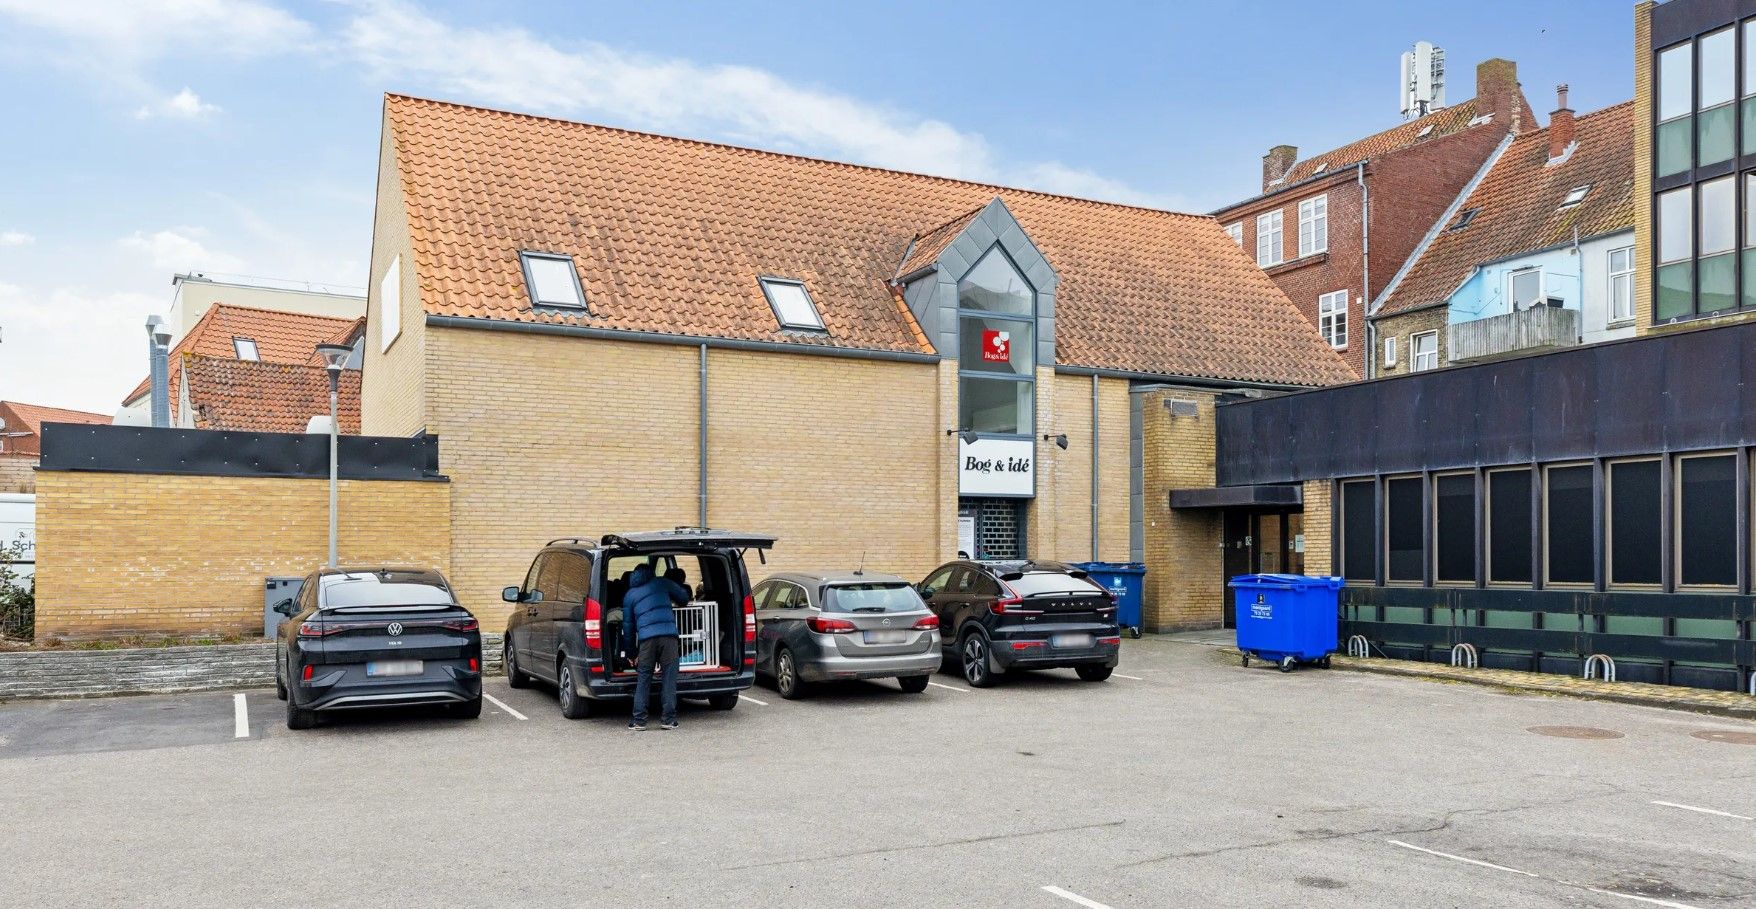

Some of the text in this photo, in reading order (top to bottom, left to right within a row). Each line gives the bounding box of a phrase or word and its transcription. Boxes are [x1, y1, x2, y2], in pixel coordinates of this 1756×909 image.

[965, 456, 1030, 474] Bog & idé
